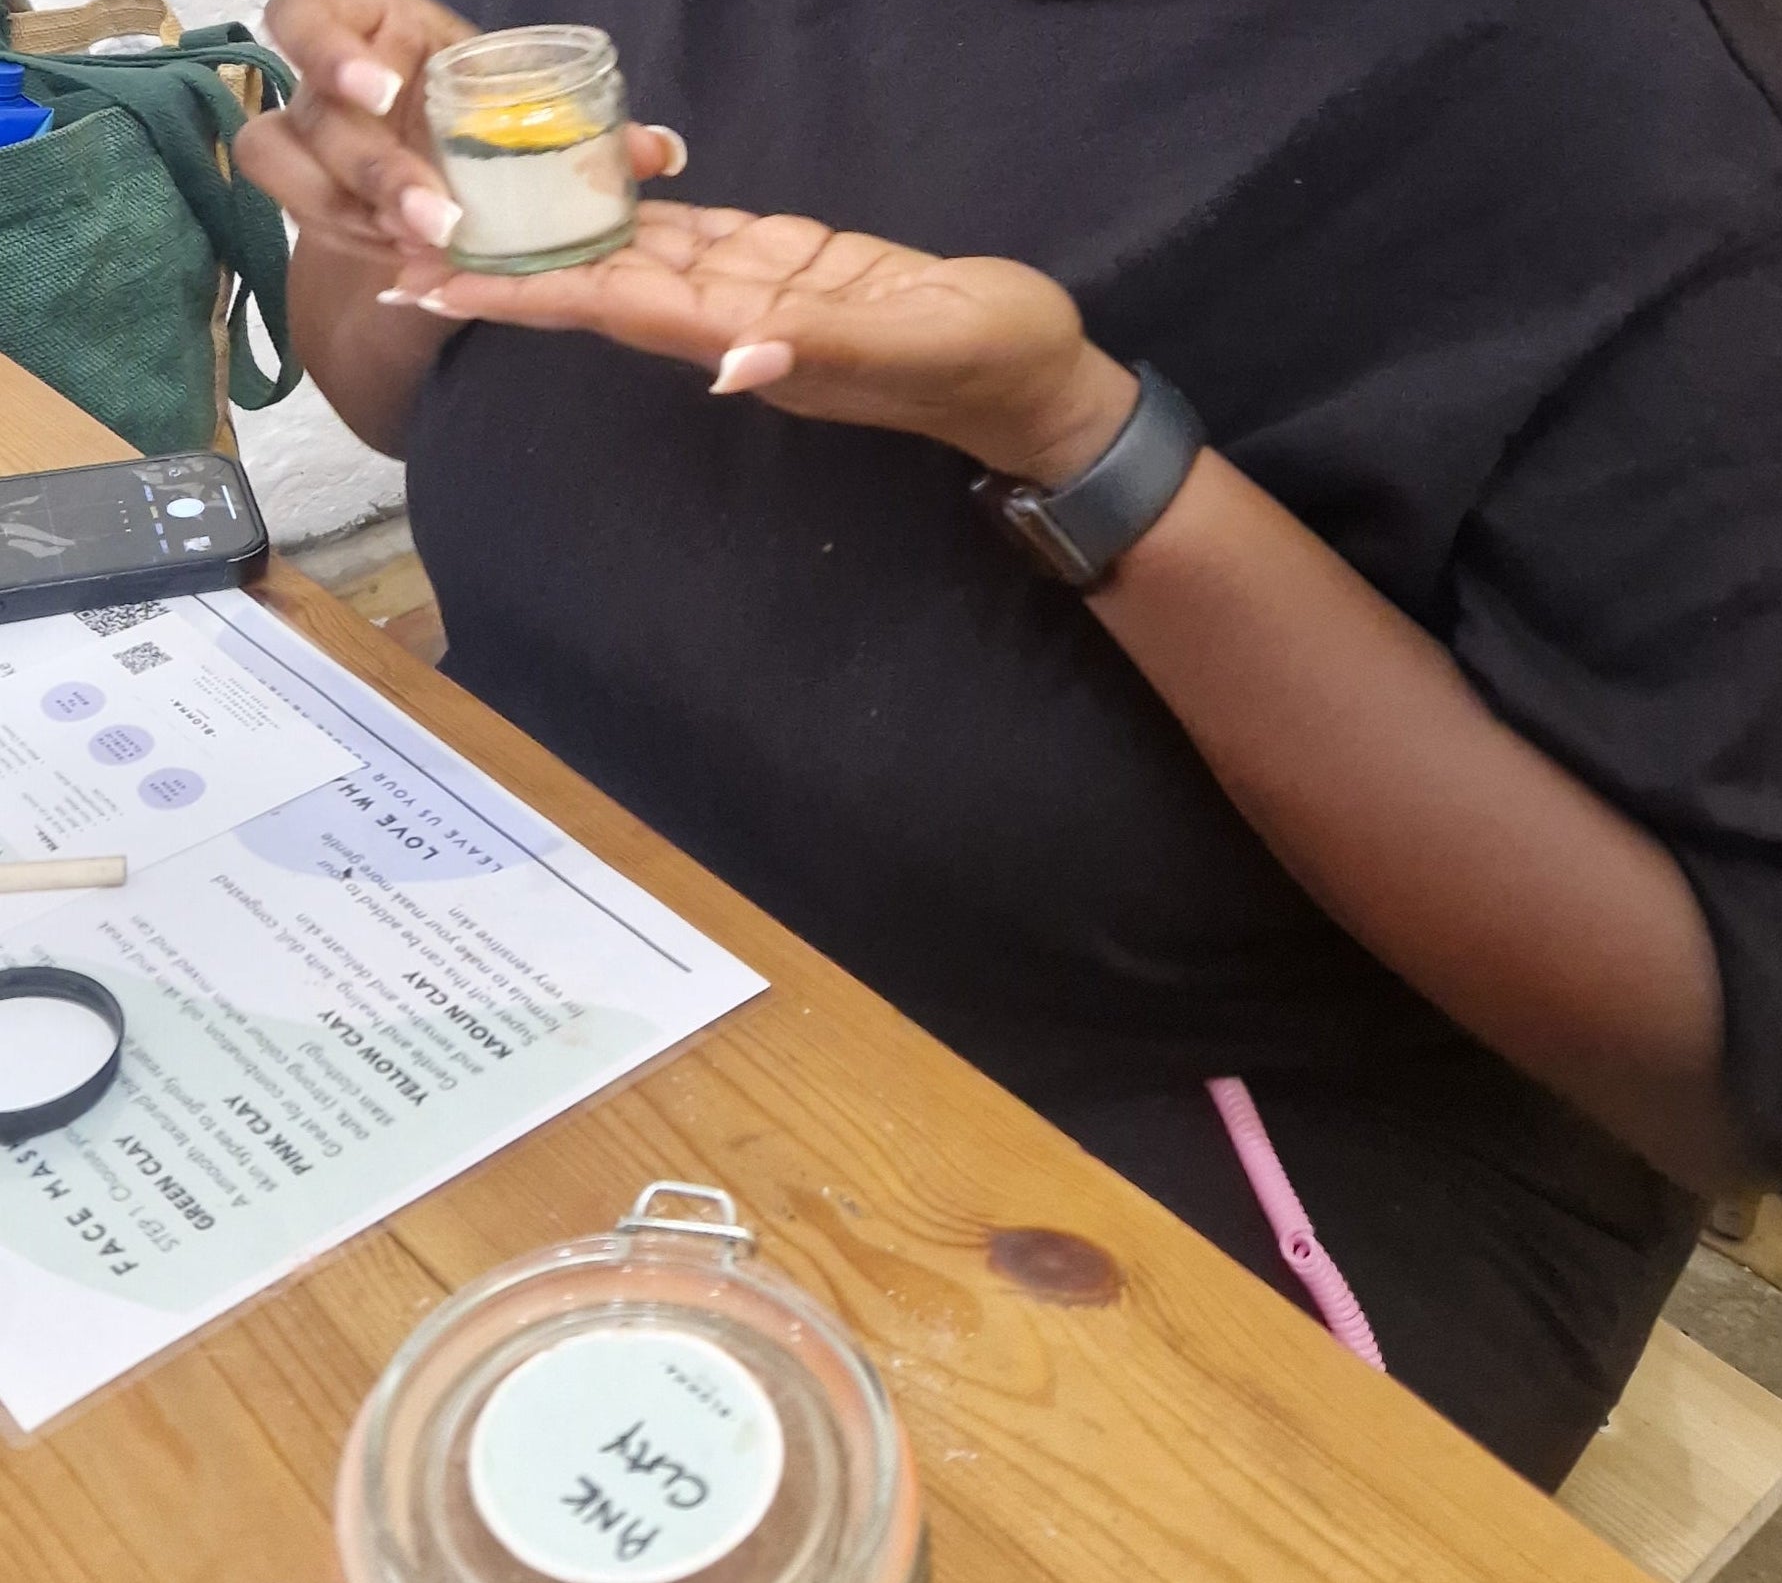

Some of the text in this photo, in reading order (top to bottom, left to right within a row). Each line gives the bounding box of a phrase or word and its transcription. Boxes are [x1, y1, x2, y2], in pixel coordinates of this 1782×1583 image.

[369, 770, 504, 874] LEAVE US YOUR
[373, 812, 440, 861] LOVE
[208, 870, 283, 931] congested
[341, 882, 362, 897] to
[129, 913, 155, 936] can
[316, 830, 563, 1032] formula to make your mask more gentle
[354, 894, 403, 932] added
[445, 905, 480, 931] skin
[148, 934, 179, 959] and
[395, 928, 422, 948] be
[417, 944, 448, 968] can
[472, 928, 534, 976] sensitive
[126, 950, 157, 975] and
[439, 966, 471, 990] this
[290, 912, 485, 1078] and sensitive and delicate skin
[464, 986, 498, 1011] soft
[529, 971, 568, 999] very
[401, 967, 514, 1060] KAOLIN CLAY
[490, 1007, 541, 1046] Super
[315, 1006, 432, 1106] YELLOW CLAY
[378, 1024, 415, 1052] and
[404, 1046, 461, 1092] Gentle
[193, 1113, 218, 1131] to
[274, 1098, 306, 1122] for
[355, 1093, 395, 1128] stain
[208, 1127, 256, 1167] types
[221, 1091, 313, 1176] PINK CLAY
[294, 1116, 345, 1159] Great
[112, 1131, 165, 1178] CLAY
[242, 1163, 280, 1194] skin
[152, 1173, 218, 1233] GREEN
[62, 1205, 141, 1277] FACE
[134, 1213, 182, 1254] STEP
[599, 1419, 709, 1508] CLAY
[560, 1473, 662, 1562] PINK
